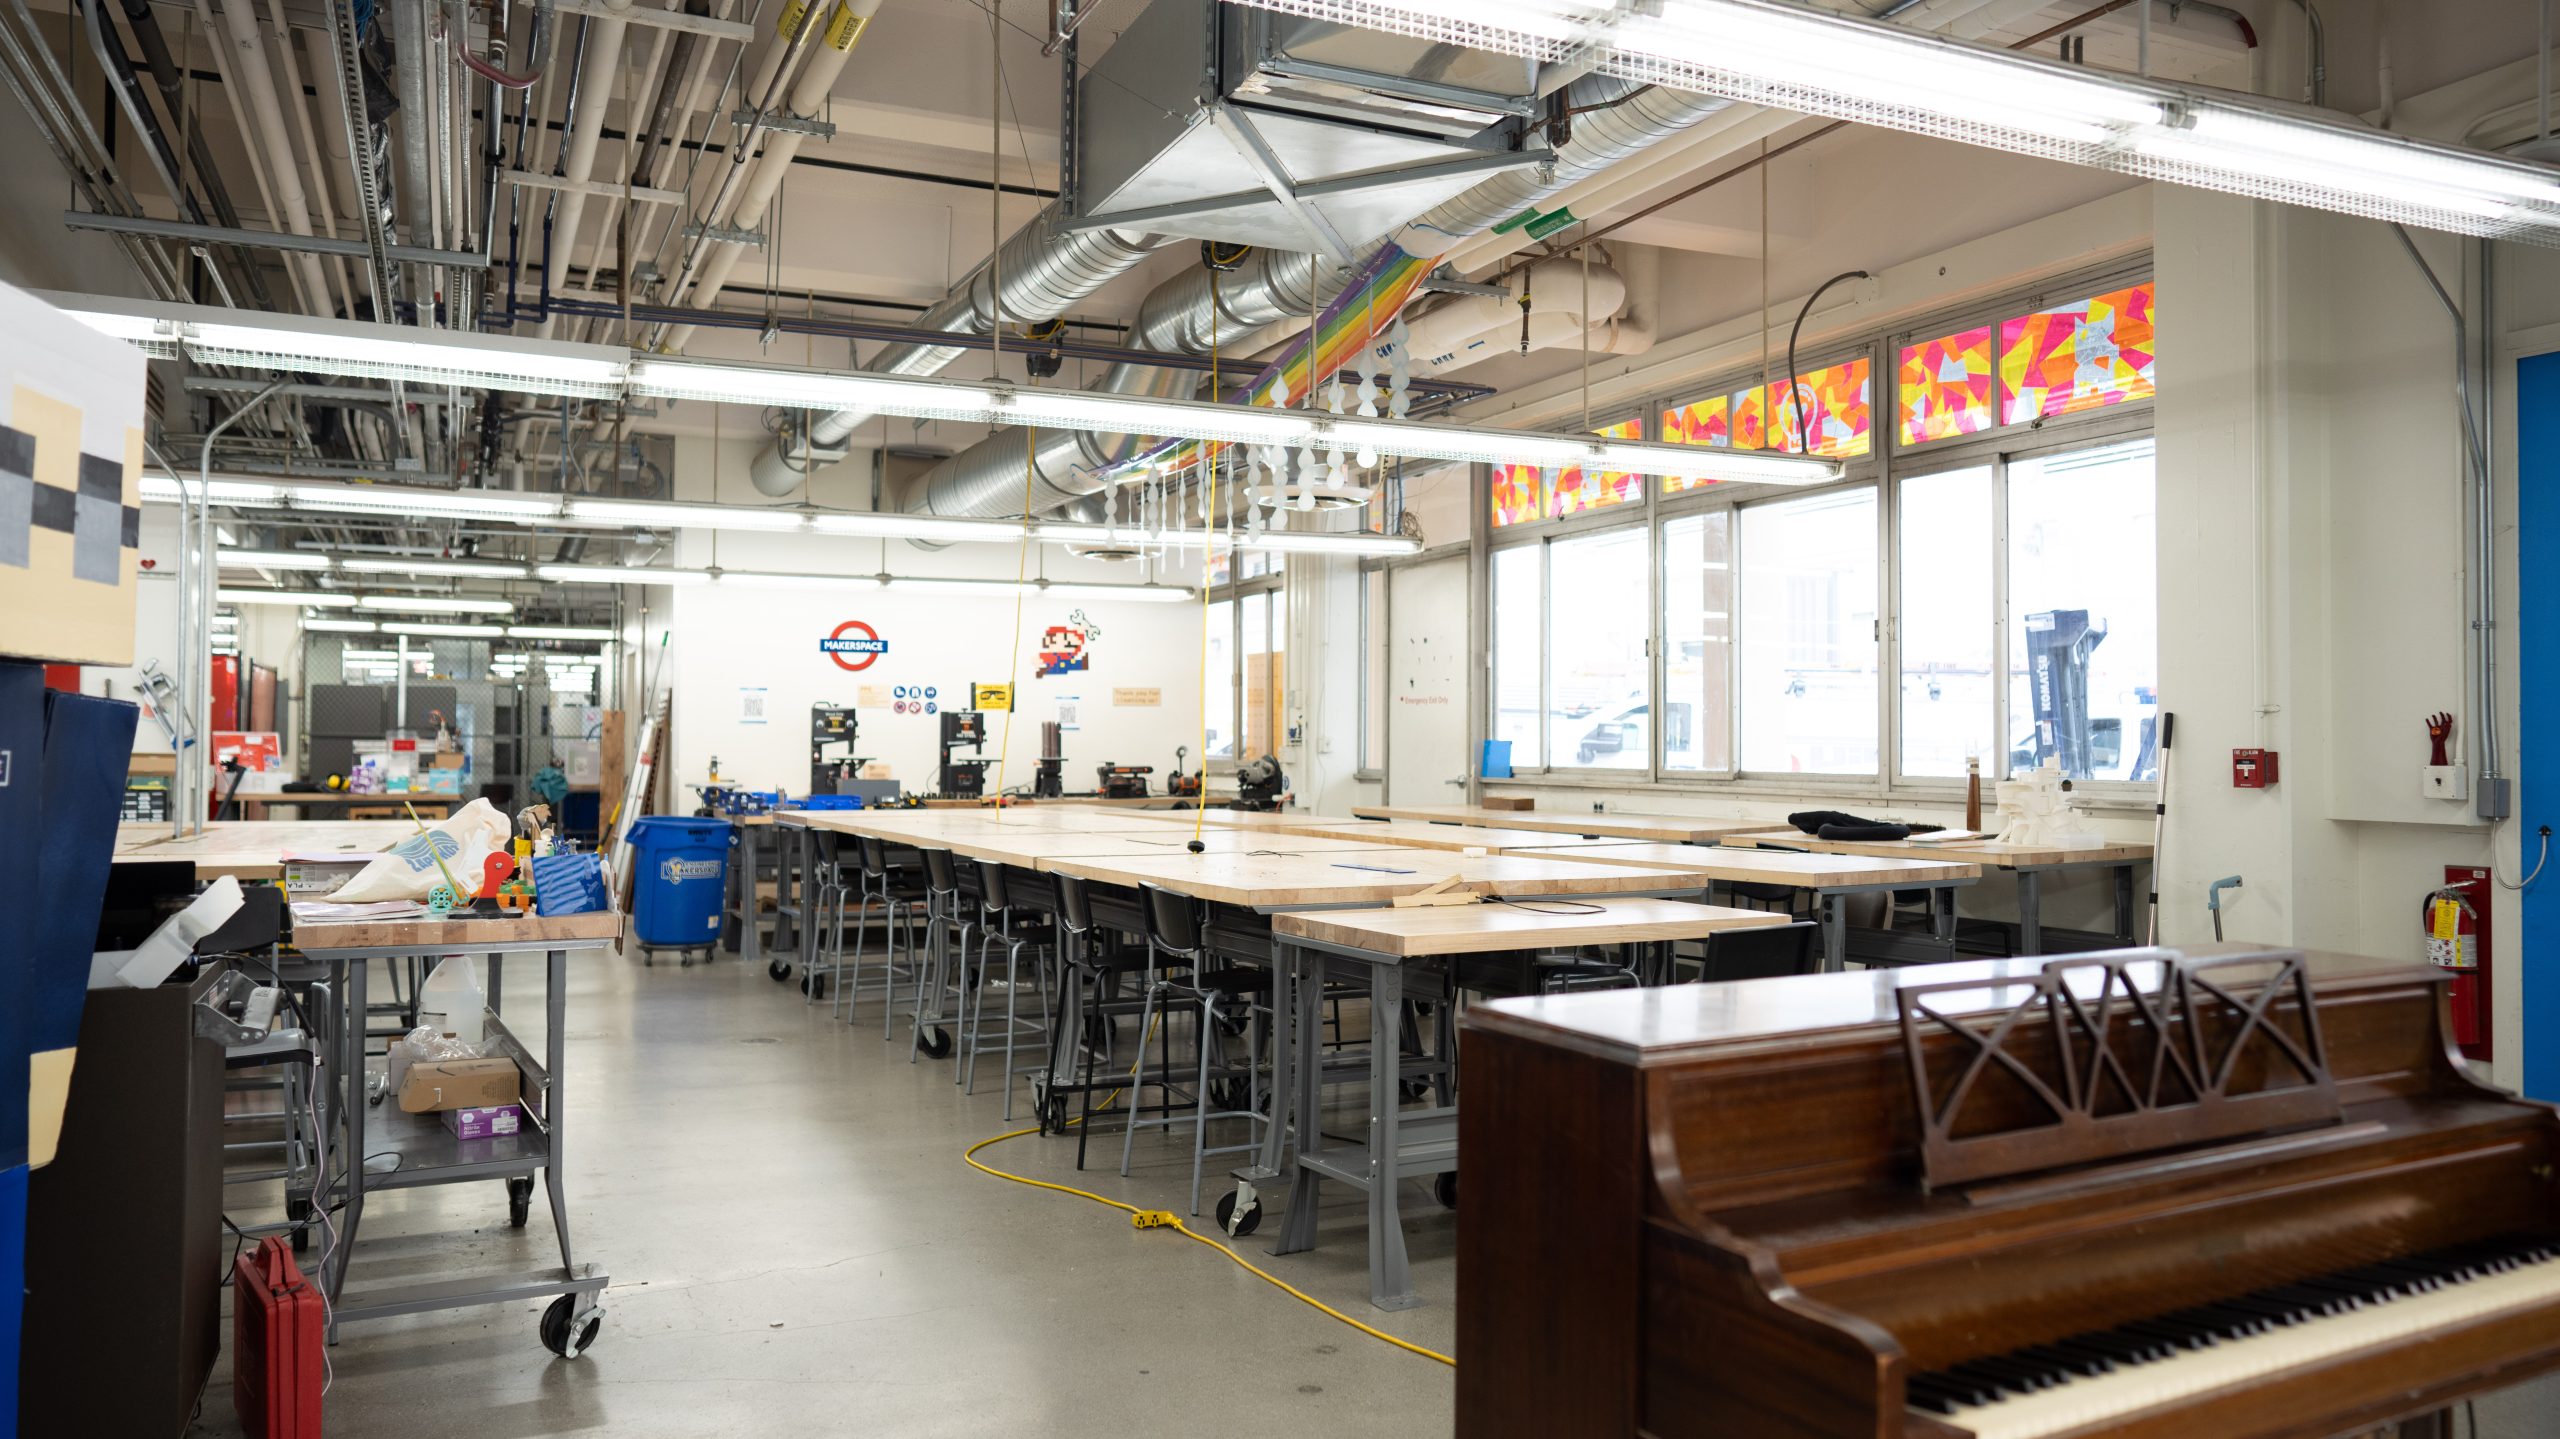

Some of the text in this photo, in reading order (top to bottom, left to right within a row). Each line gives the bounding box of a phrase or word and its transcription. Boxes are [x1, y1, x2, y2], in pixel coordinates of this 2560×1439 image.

[823, 641, 883, 652] MAKERSPACE
[2037, 655, 2051, 711] KOMATSU
[1405, 696, 1428, 706] Emergency
